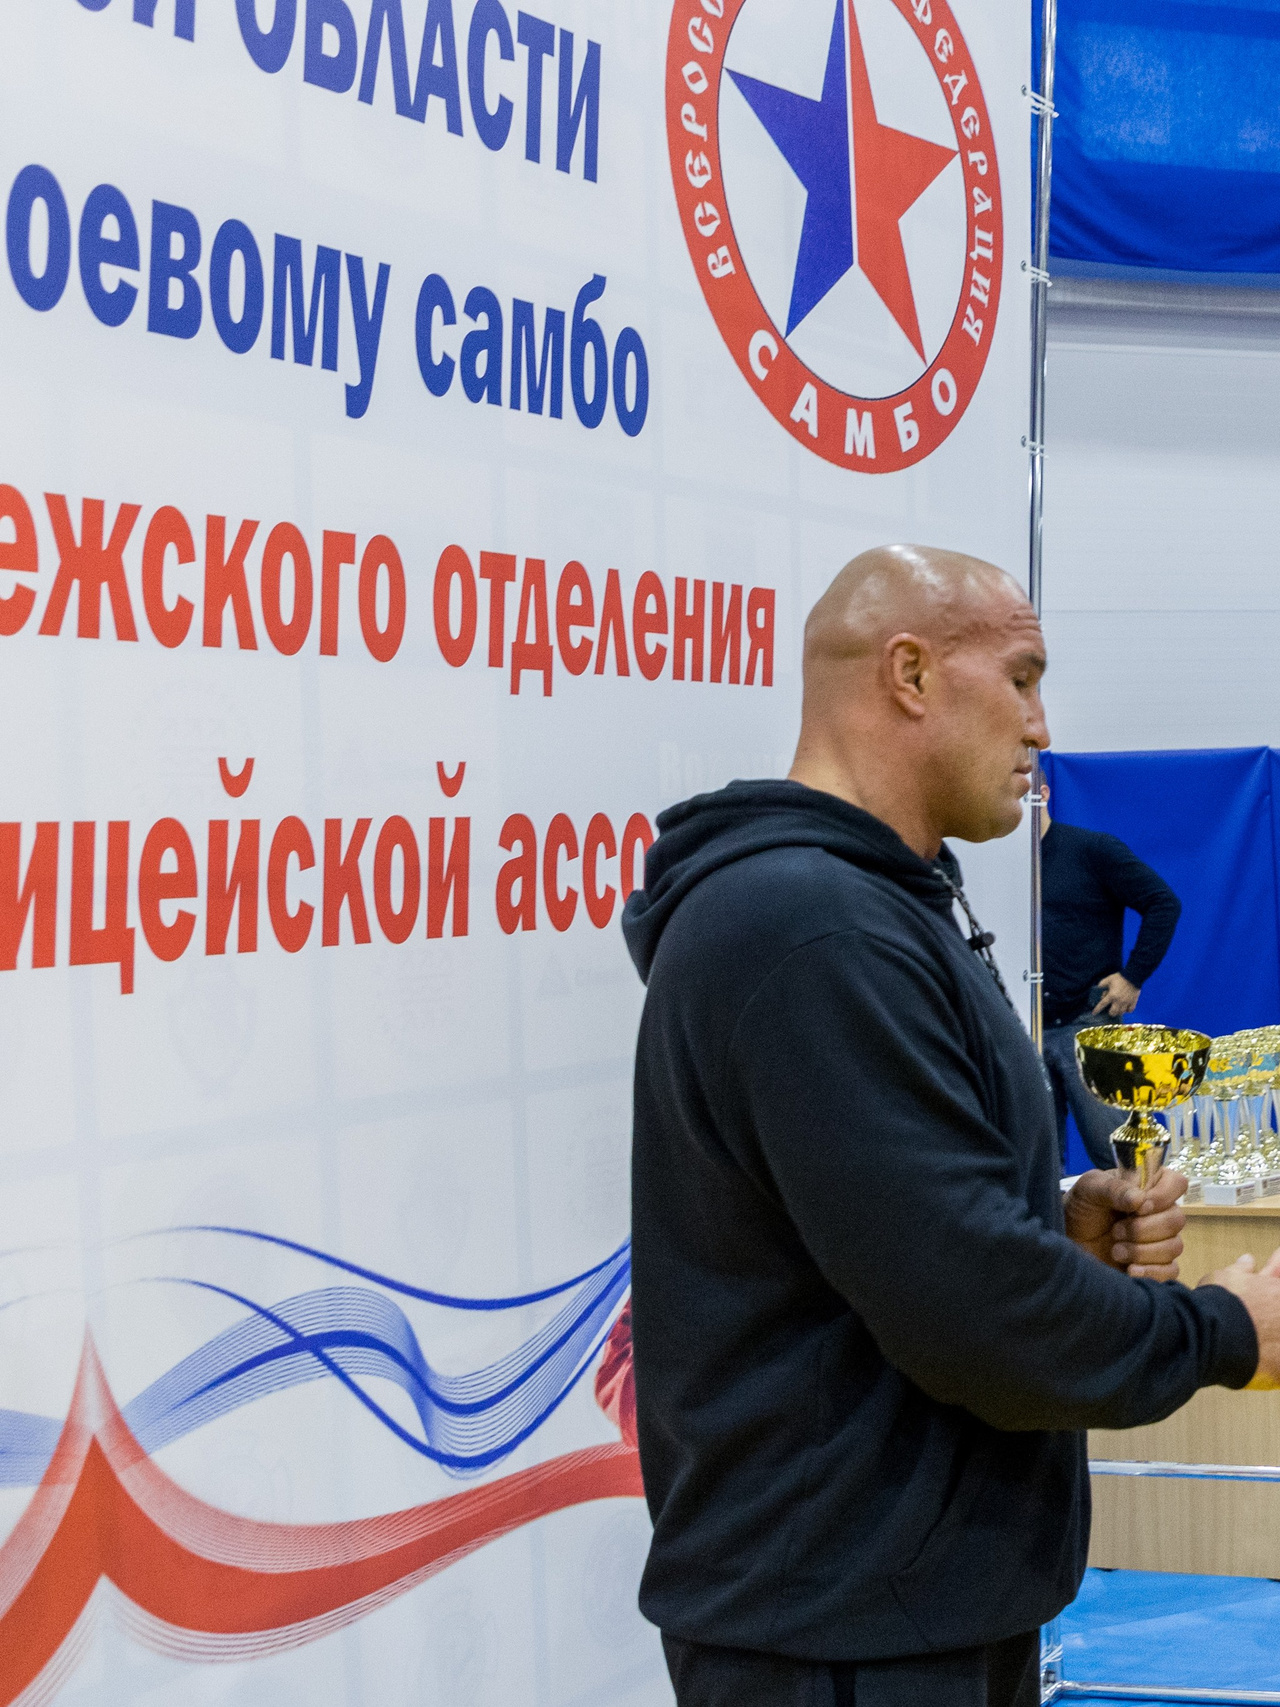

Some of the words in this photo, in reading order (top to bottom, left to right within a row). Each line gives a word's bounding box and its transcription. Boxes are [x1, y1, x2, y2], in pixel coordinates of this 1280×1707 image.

[5, 163, 392, 420] оевому
[414, 272, 650, 438] самбо
[747, 328, 957, 460] САМБО
[0, 483, 407, 664] ежского
[432, 543, 777, 698] отделения
[0, 757, 472, 996] ицейской
